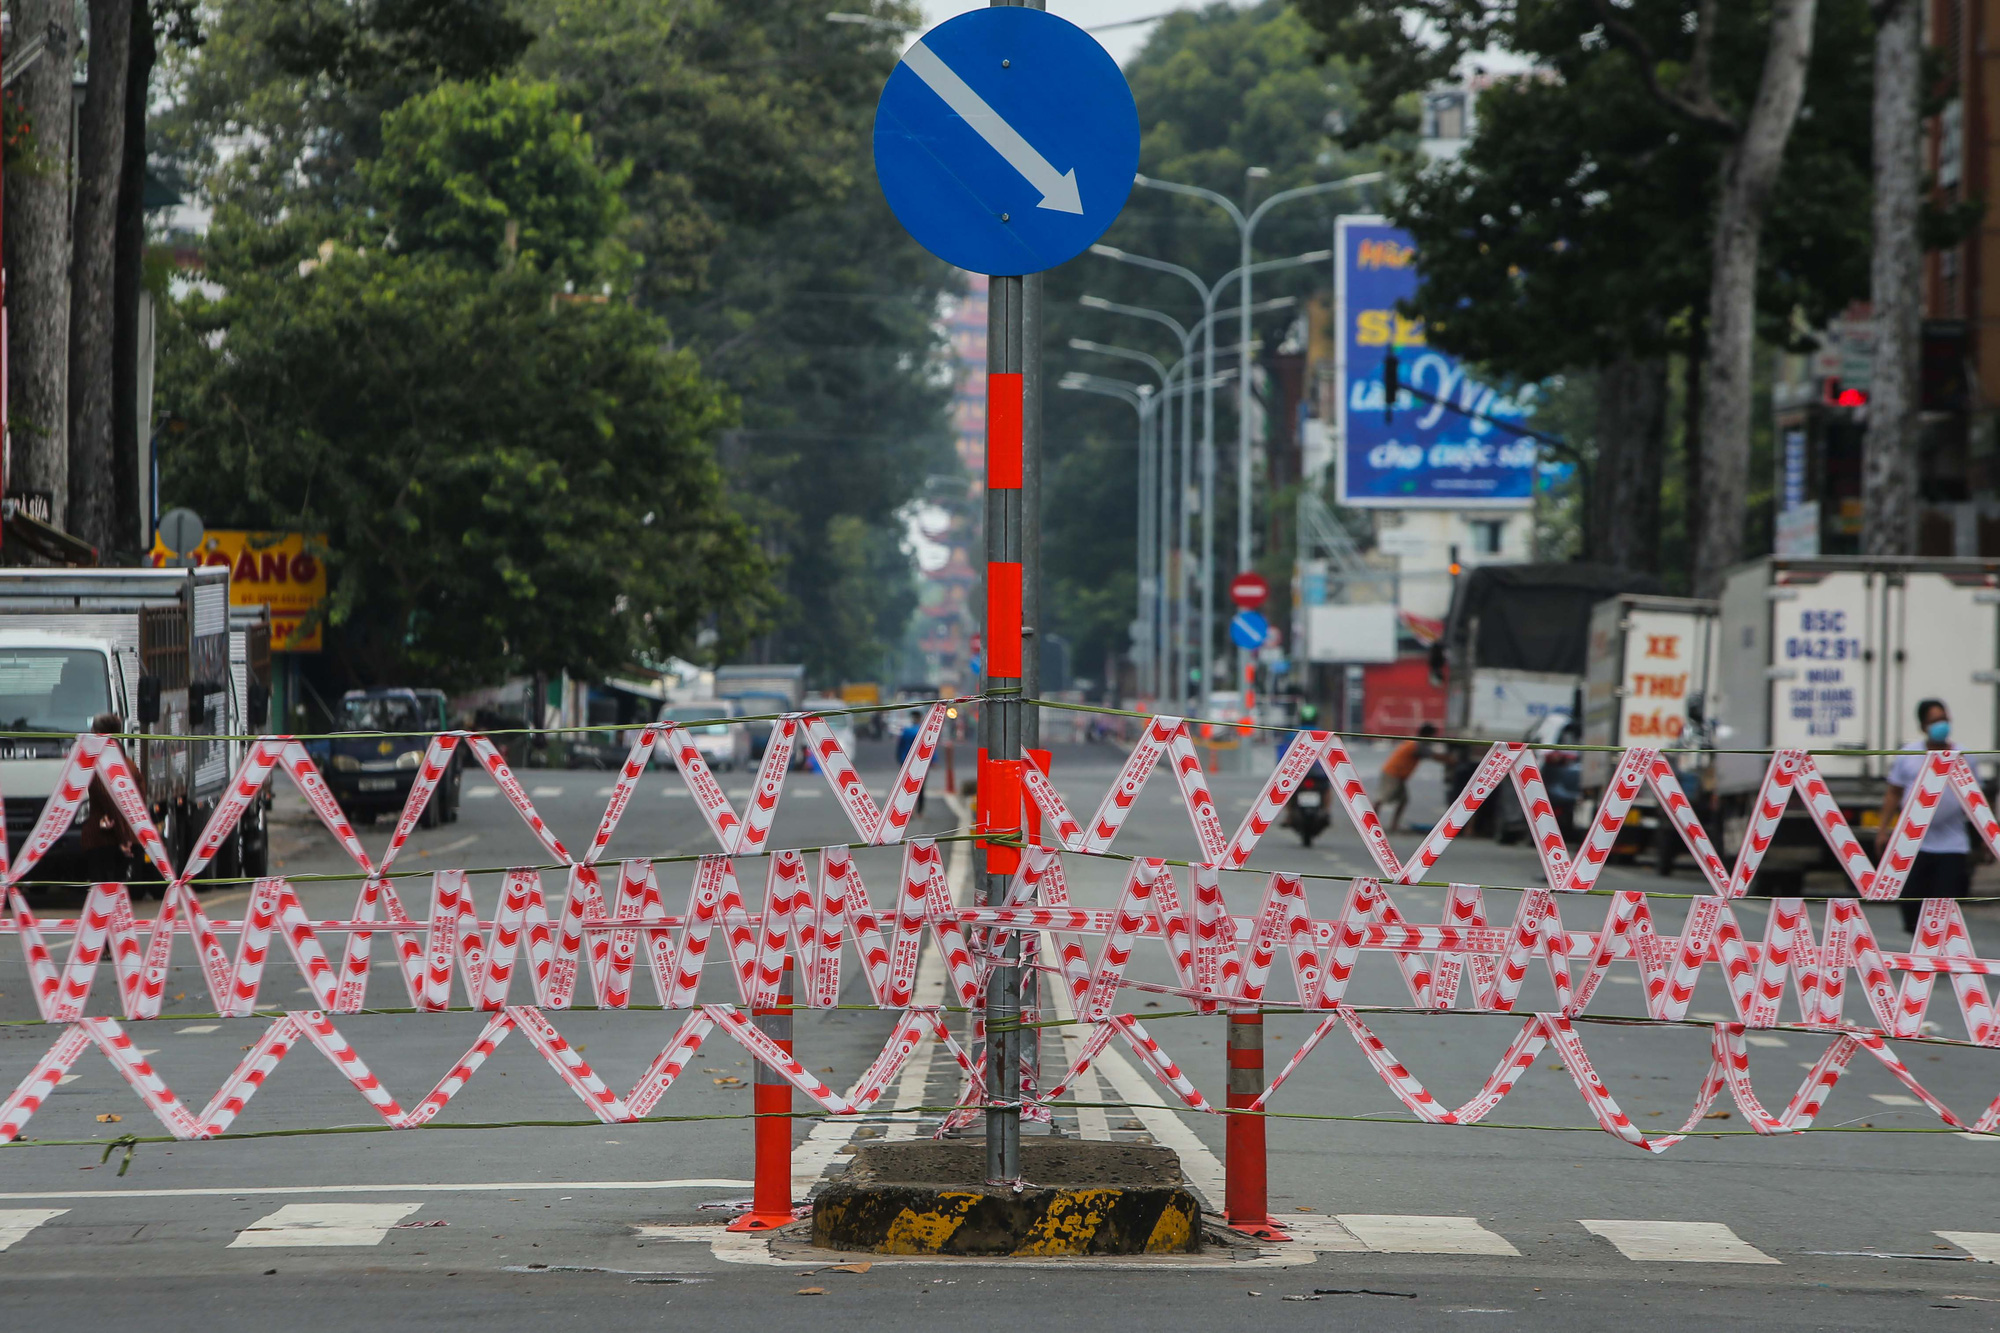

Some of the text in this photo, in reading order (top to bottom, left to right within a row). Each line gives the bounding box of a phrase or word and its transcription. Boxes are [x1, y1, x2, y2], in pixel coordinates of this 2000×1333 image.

[1645, 634, 1681, 660] XE
[1632, 671, 1688, 700] THƯ
[1627, 707, 1684, 739] BÁO
